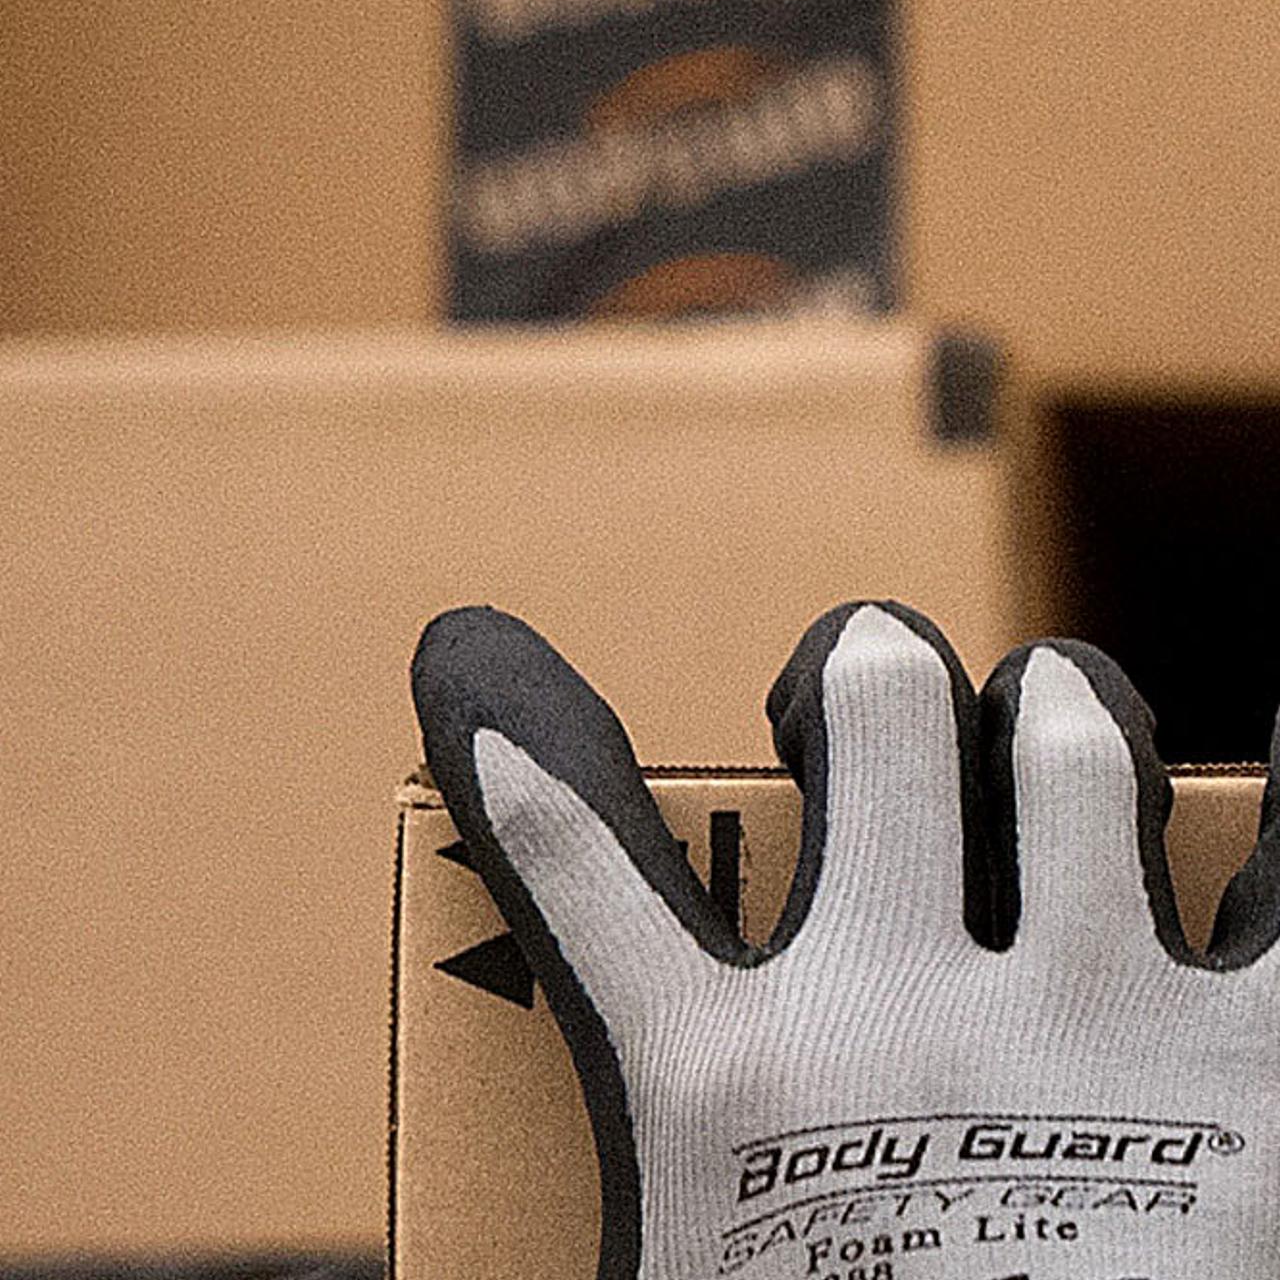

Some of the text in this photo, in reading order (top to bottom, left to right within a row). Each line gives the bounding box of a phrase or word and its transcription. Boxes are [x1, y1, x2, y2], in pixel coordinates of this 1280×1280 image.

[738, 1128, 930, 1204] Body
[806, 1214, 1079, 1276] Foam Lite
